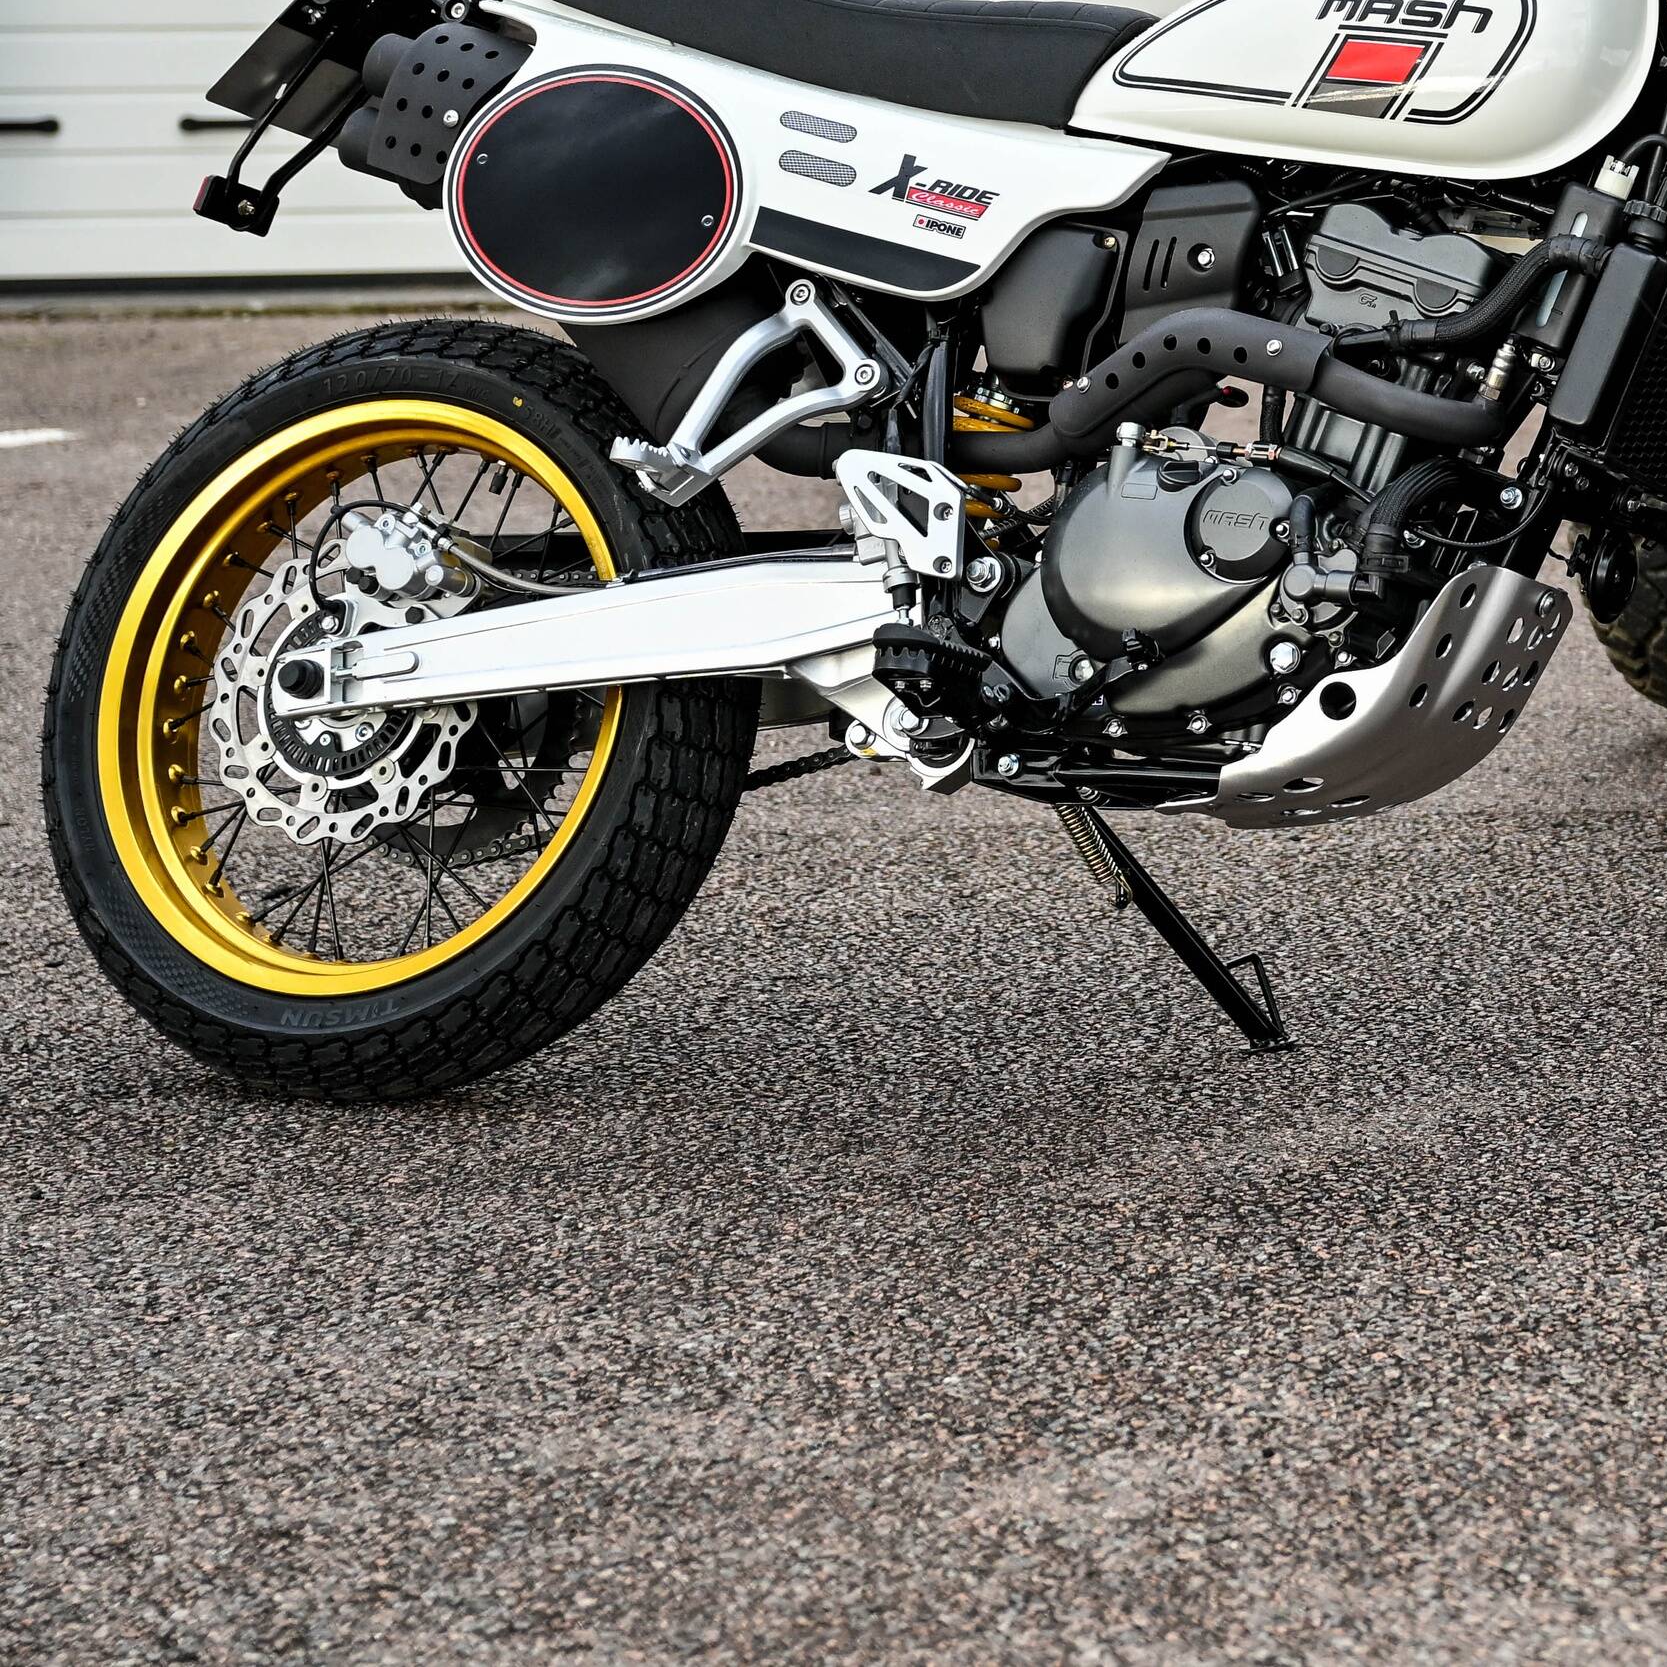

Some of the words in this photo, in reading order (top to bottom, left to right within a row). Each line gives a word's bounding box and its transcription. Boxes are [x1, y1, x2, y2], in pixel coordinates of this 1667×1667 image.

[868, 154, 1000, 202] X-RIDE
[911, 192, 981, 215] Classic
[926, 219, 965, 237] IPONE
